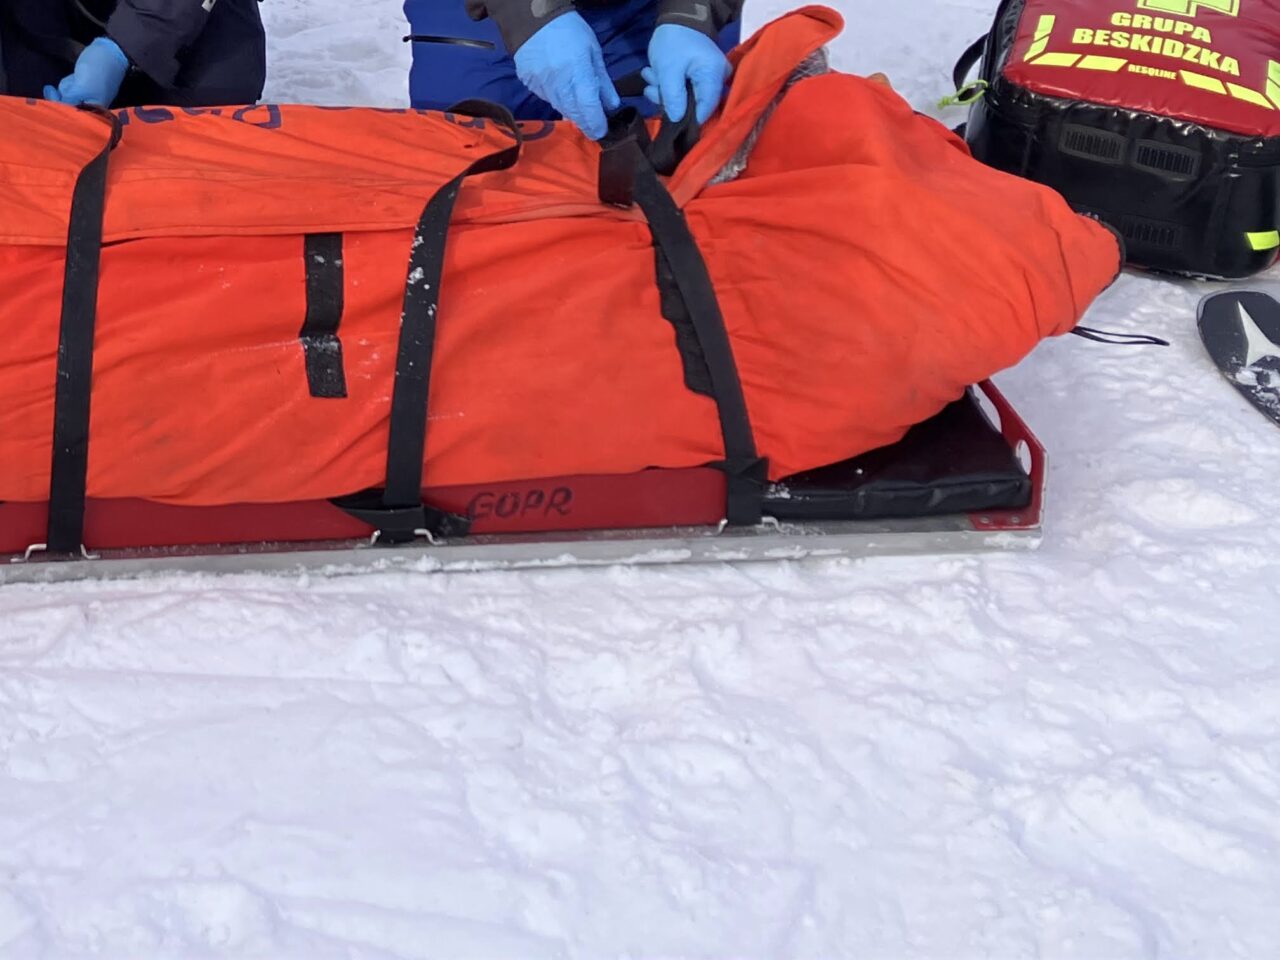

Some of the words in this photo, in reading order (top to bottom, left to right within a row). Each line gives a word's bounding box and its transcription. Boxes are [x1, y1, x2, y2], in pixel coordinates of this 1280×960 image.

[1110, 11, 1212, 44] GRUPA
[1072, 27, 1240, 77] BESKIDZKA
[467, 487, 573, 518] GOPR
